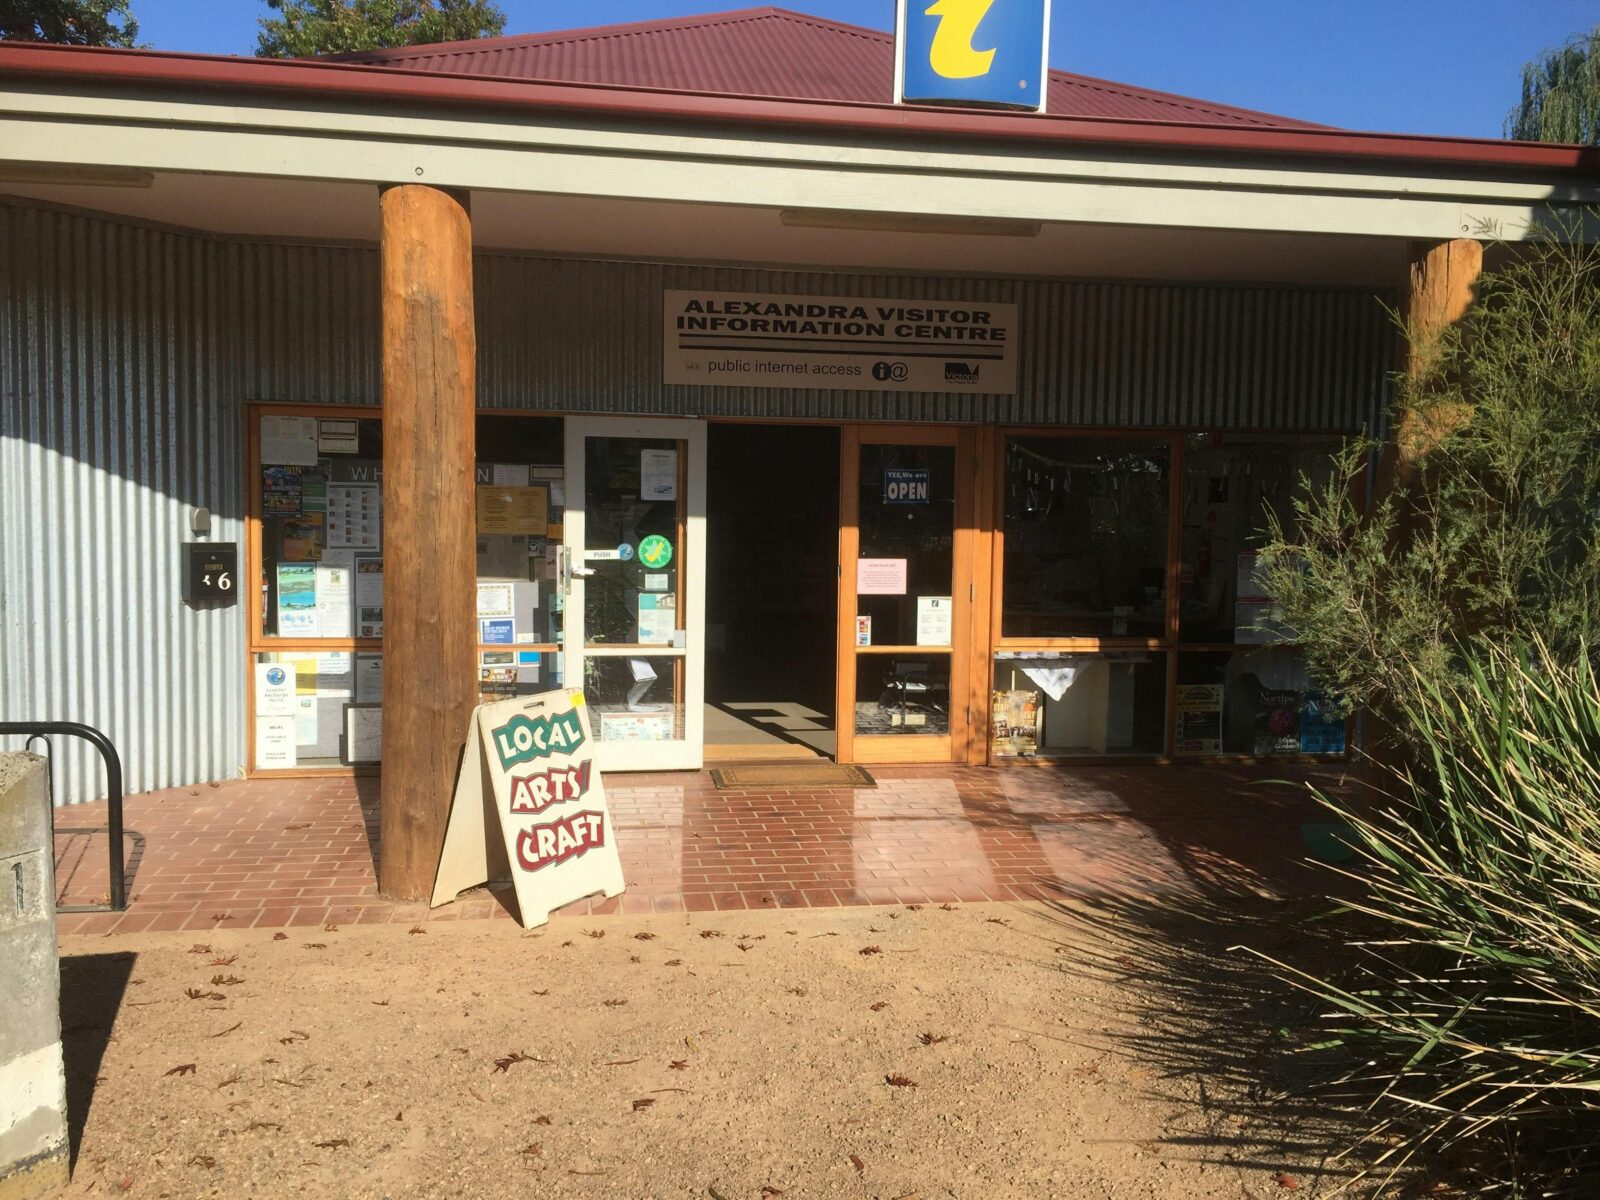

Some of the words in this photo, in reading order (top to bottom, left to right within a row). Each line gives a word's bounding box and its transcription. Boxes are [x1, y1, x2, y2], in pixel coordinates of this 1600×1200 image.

[684, 300, 870, 321] ALEXANDRA
[876, 307, 991, 325] VISITOR
[676, 316, 885, 338] INFORMATION
[894, 323, 1006, 341] CENTRE
[708, 358, 751, 374] public
[755, 359, 808, 375] internet
[812, 363, 861, 376] access
[887, 481, 927, 500] OPEN
[499, 719, 581, 760] LOCAL
[511, 770, 581, 810] ARTS
[522, 813, 602, 863] CRAFT
